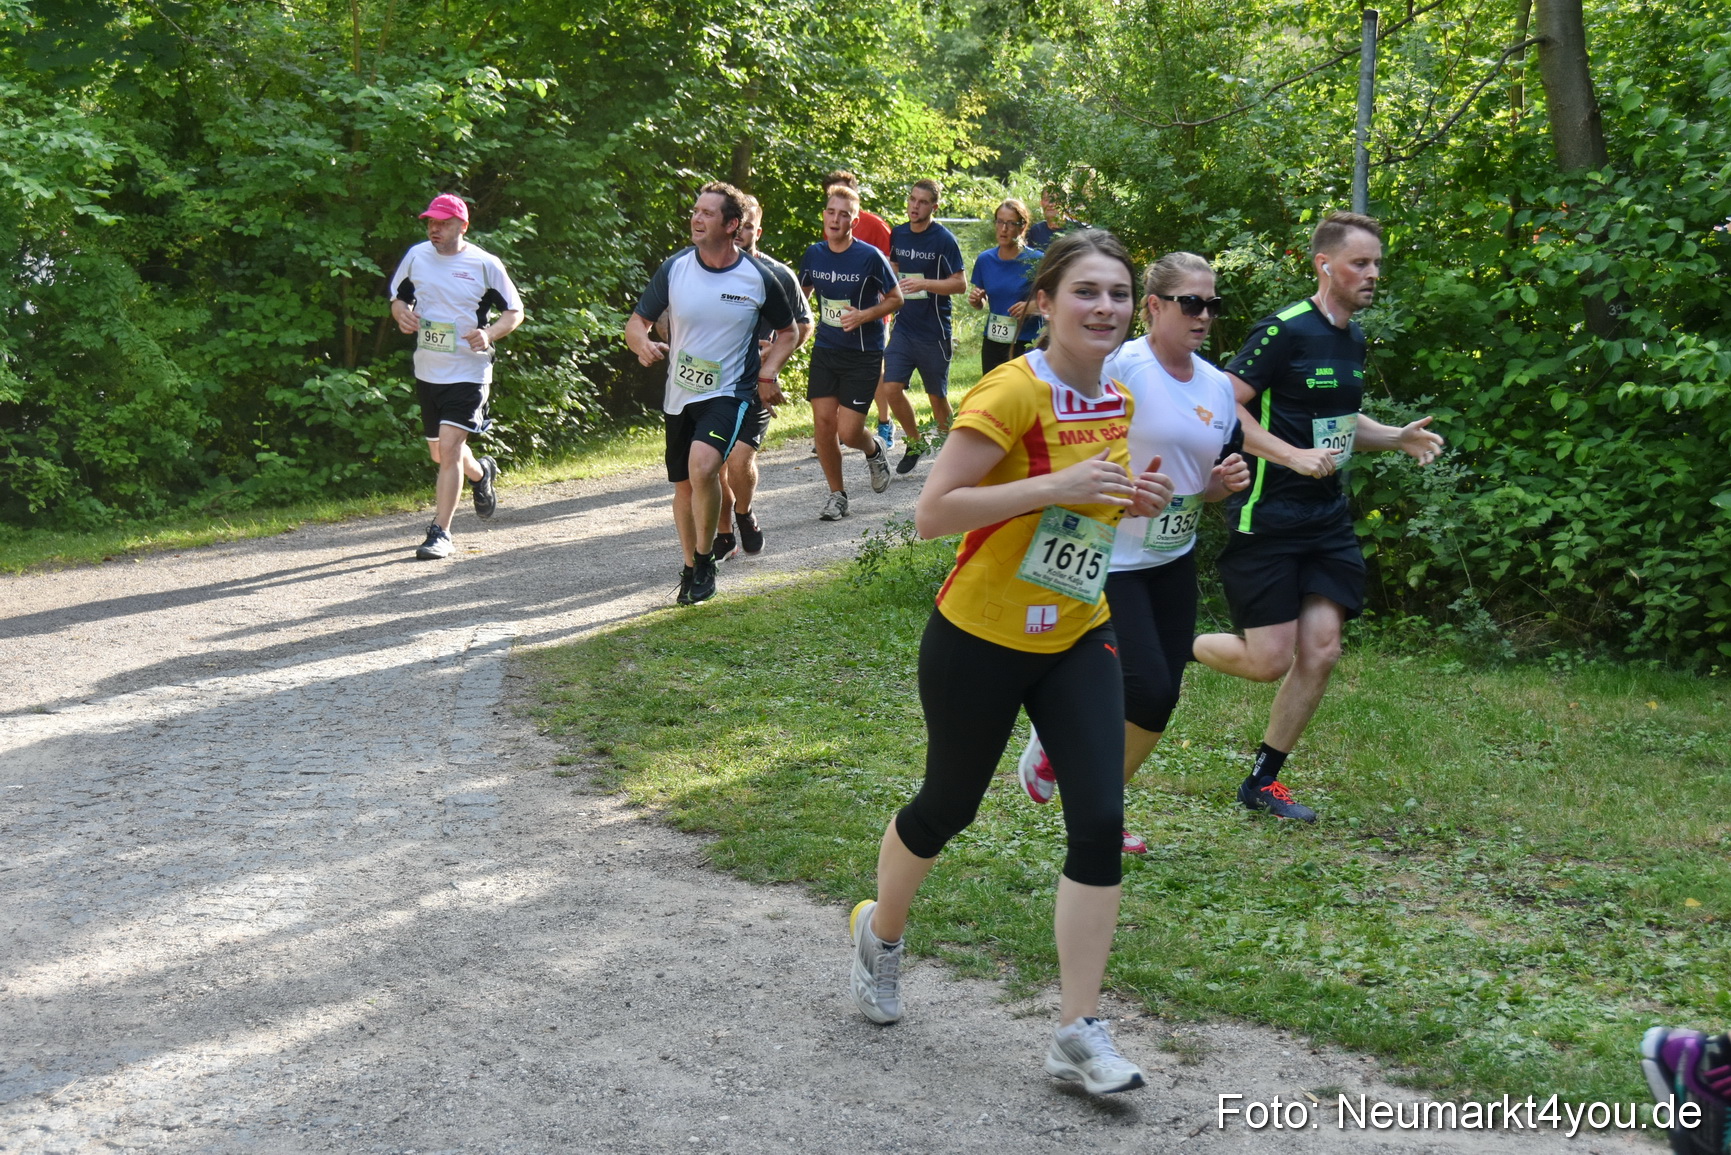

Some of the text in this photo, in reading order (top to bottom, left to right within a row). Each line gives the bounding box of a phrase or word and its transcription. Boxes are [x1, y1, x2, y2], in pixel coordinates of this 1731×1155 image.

[895, 247, 936, 260] EURO POLES
[812, 269, 860, 282] EURO POLES
[824, 307, 842, 319] 704
[991, 323, 1009, 336] 873
[424, 330, 446, 344] 967
[679, 364, 714, 386] 2276
[1058, 422, 1129, 446] MAX BÖG
[1159, 510, 1198, 535] 1352
[1042, 537, 1103, 581] 1615
